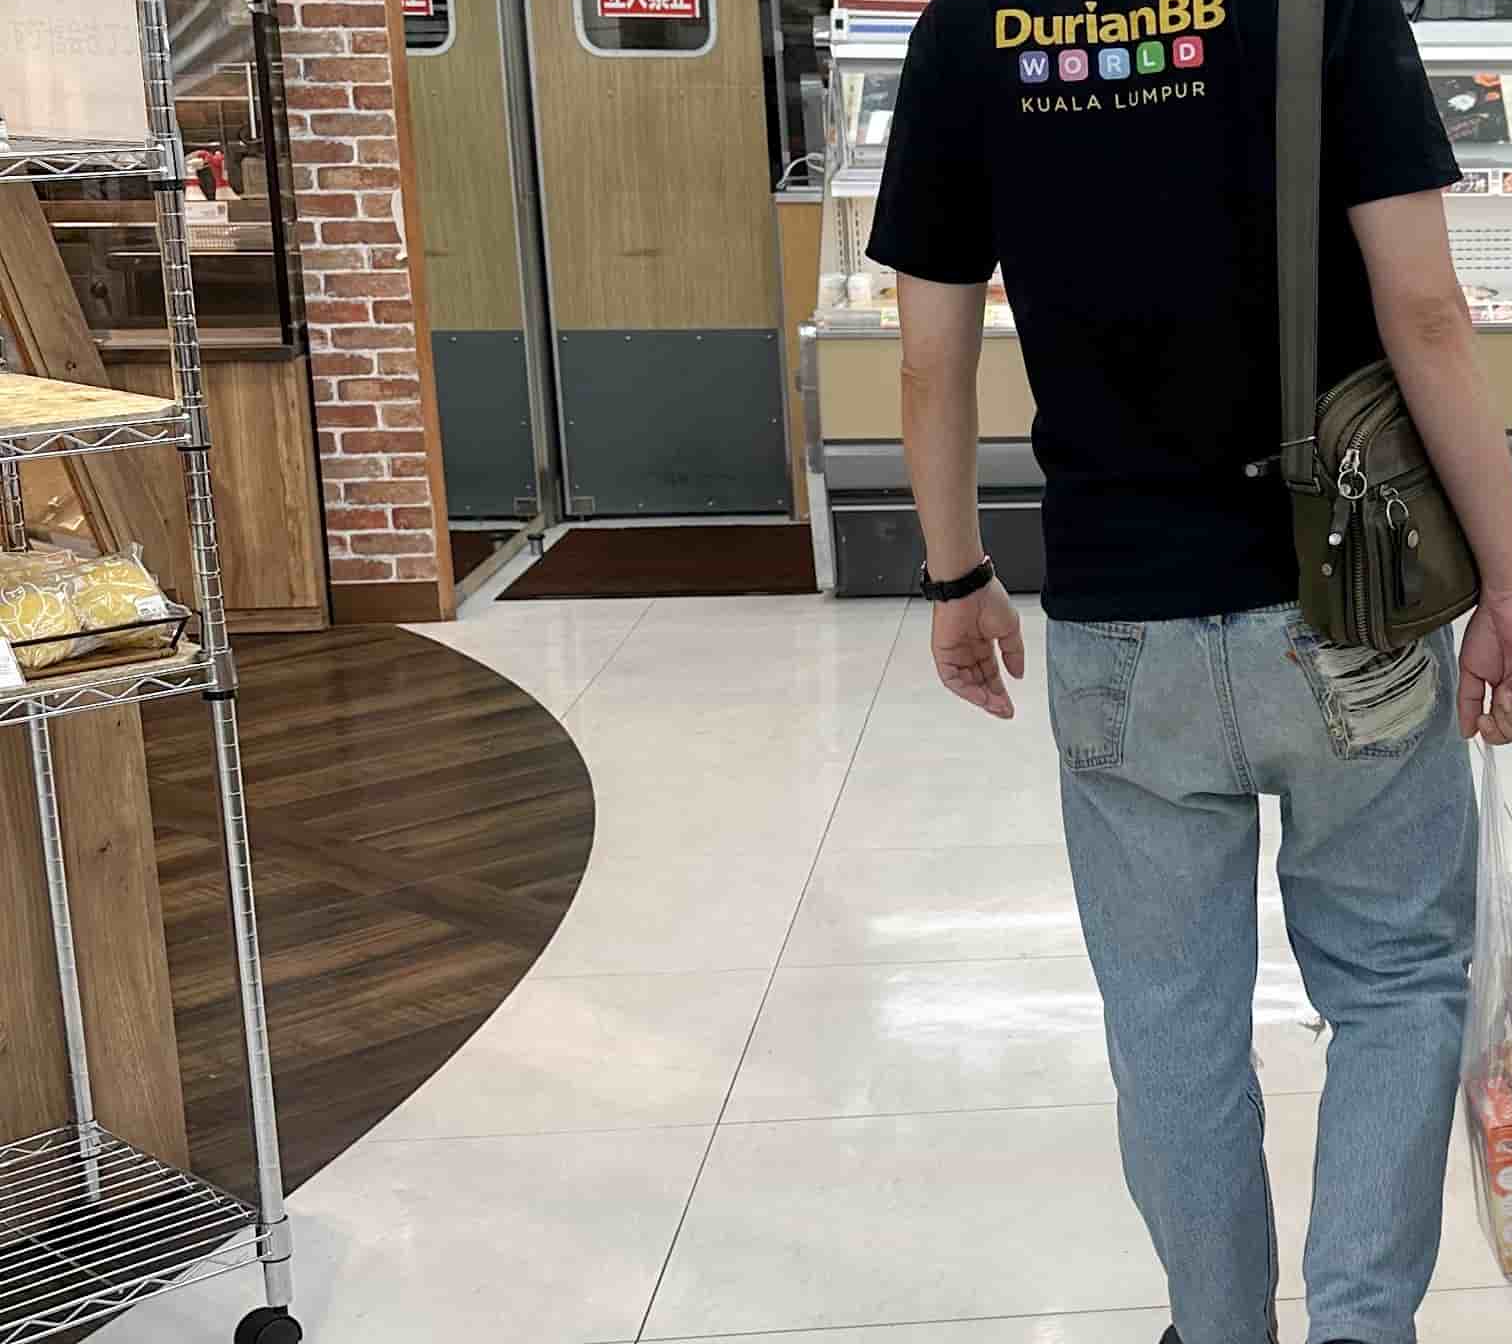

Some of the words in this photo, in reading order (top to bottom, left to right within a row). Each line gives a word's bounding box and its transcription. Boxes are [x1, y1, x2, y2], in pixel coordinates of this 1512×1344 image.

[1020, 40, 1201, 80] WORLD
[1021, 93, 1102, 113] KUALA
[1114, 81, 1206, 109] LUMPUR
